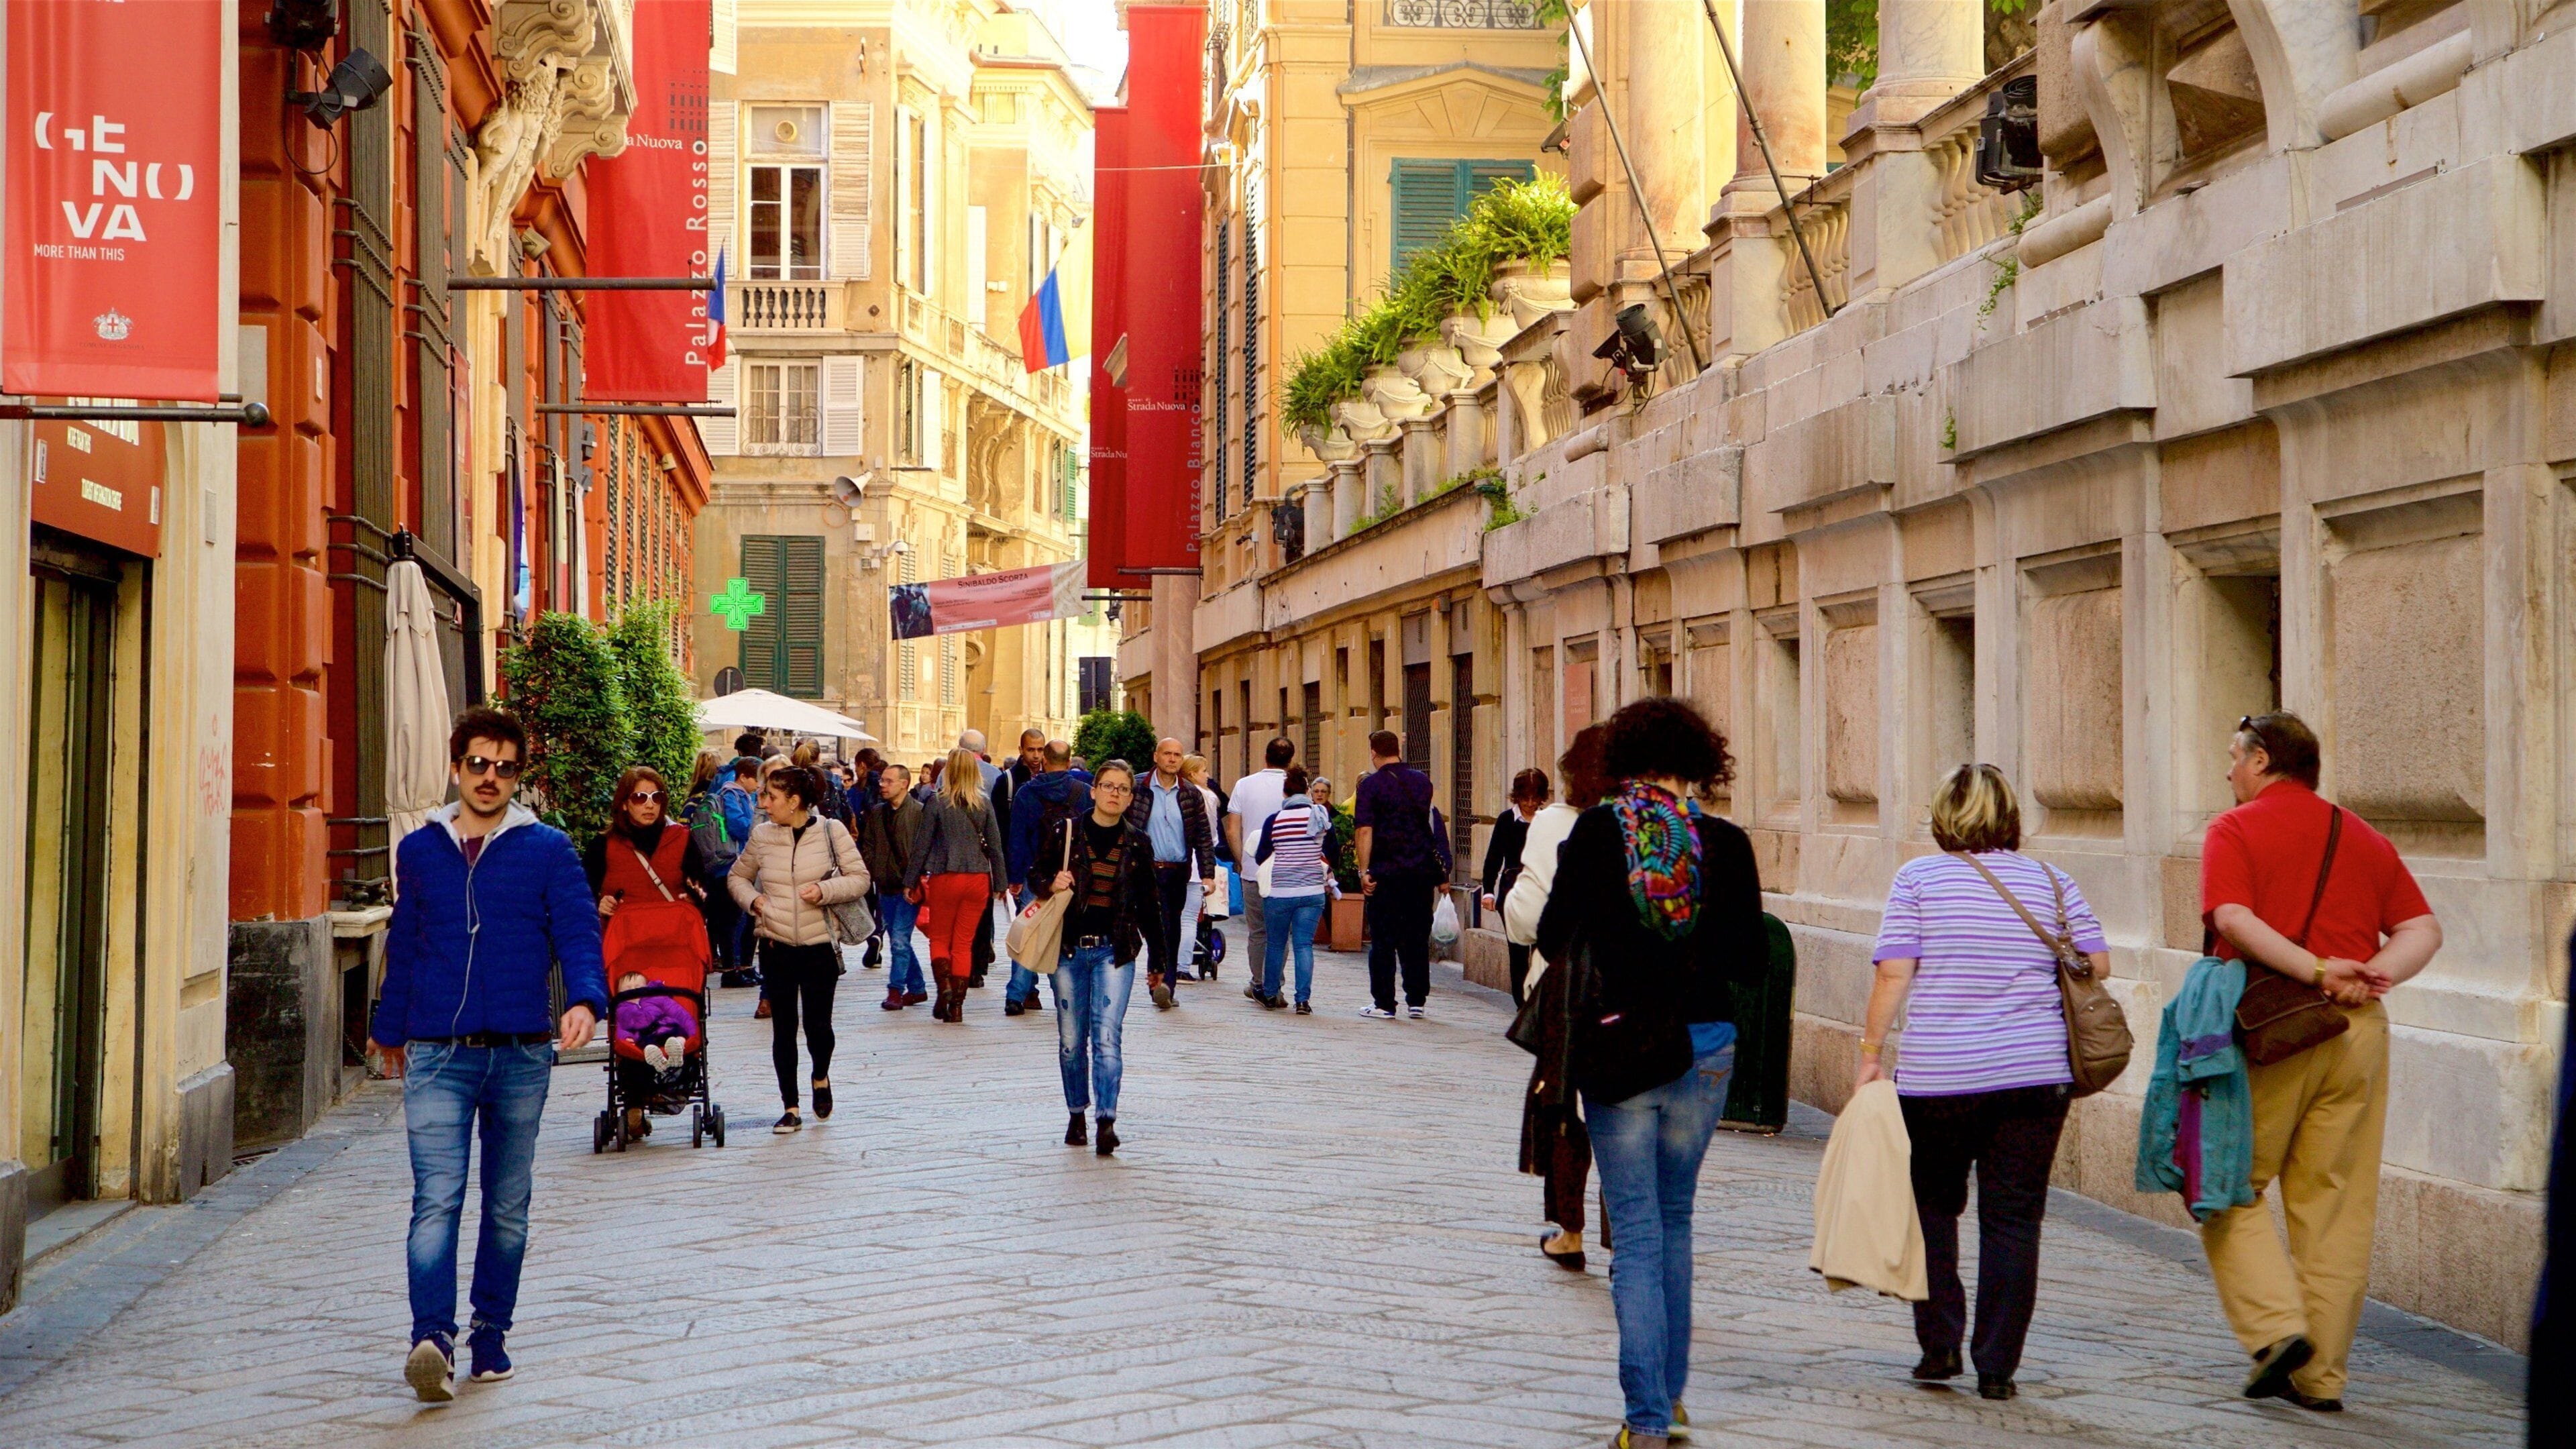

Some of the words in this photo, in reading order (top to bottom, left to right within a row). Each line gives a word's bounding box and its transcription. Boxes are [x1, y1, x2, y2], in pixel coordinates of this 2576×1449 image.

[637, 133, 683, 150] Nuova
[686, 140, 706, 231] Rosso
[34, 244, 64, 258] MORE
[68, 246, 97, 259] THAN
[100, 248, 125, 261] THIS
[1127, 401, 1155, 411] Strada
[1157, 402, 1185, 411] Nuova
[1187, 404, 1200, 468] Bianco
[1091, 449, 1115, 458] Strada
[1186, 480, 1200, 552] Palazzo
[957, 577, 997, 588] SINIBALDO
[998, 573, 1028, 583] SCORZA
